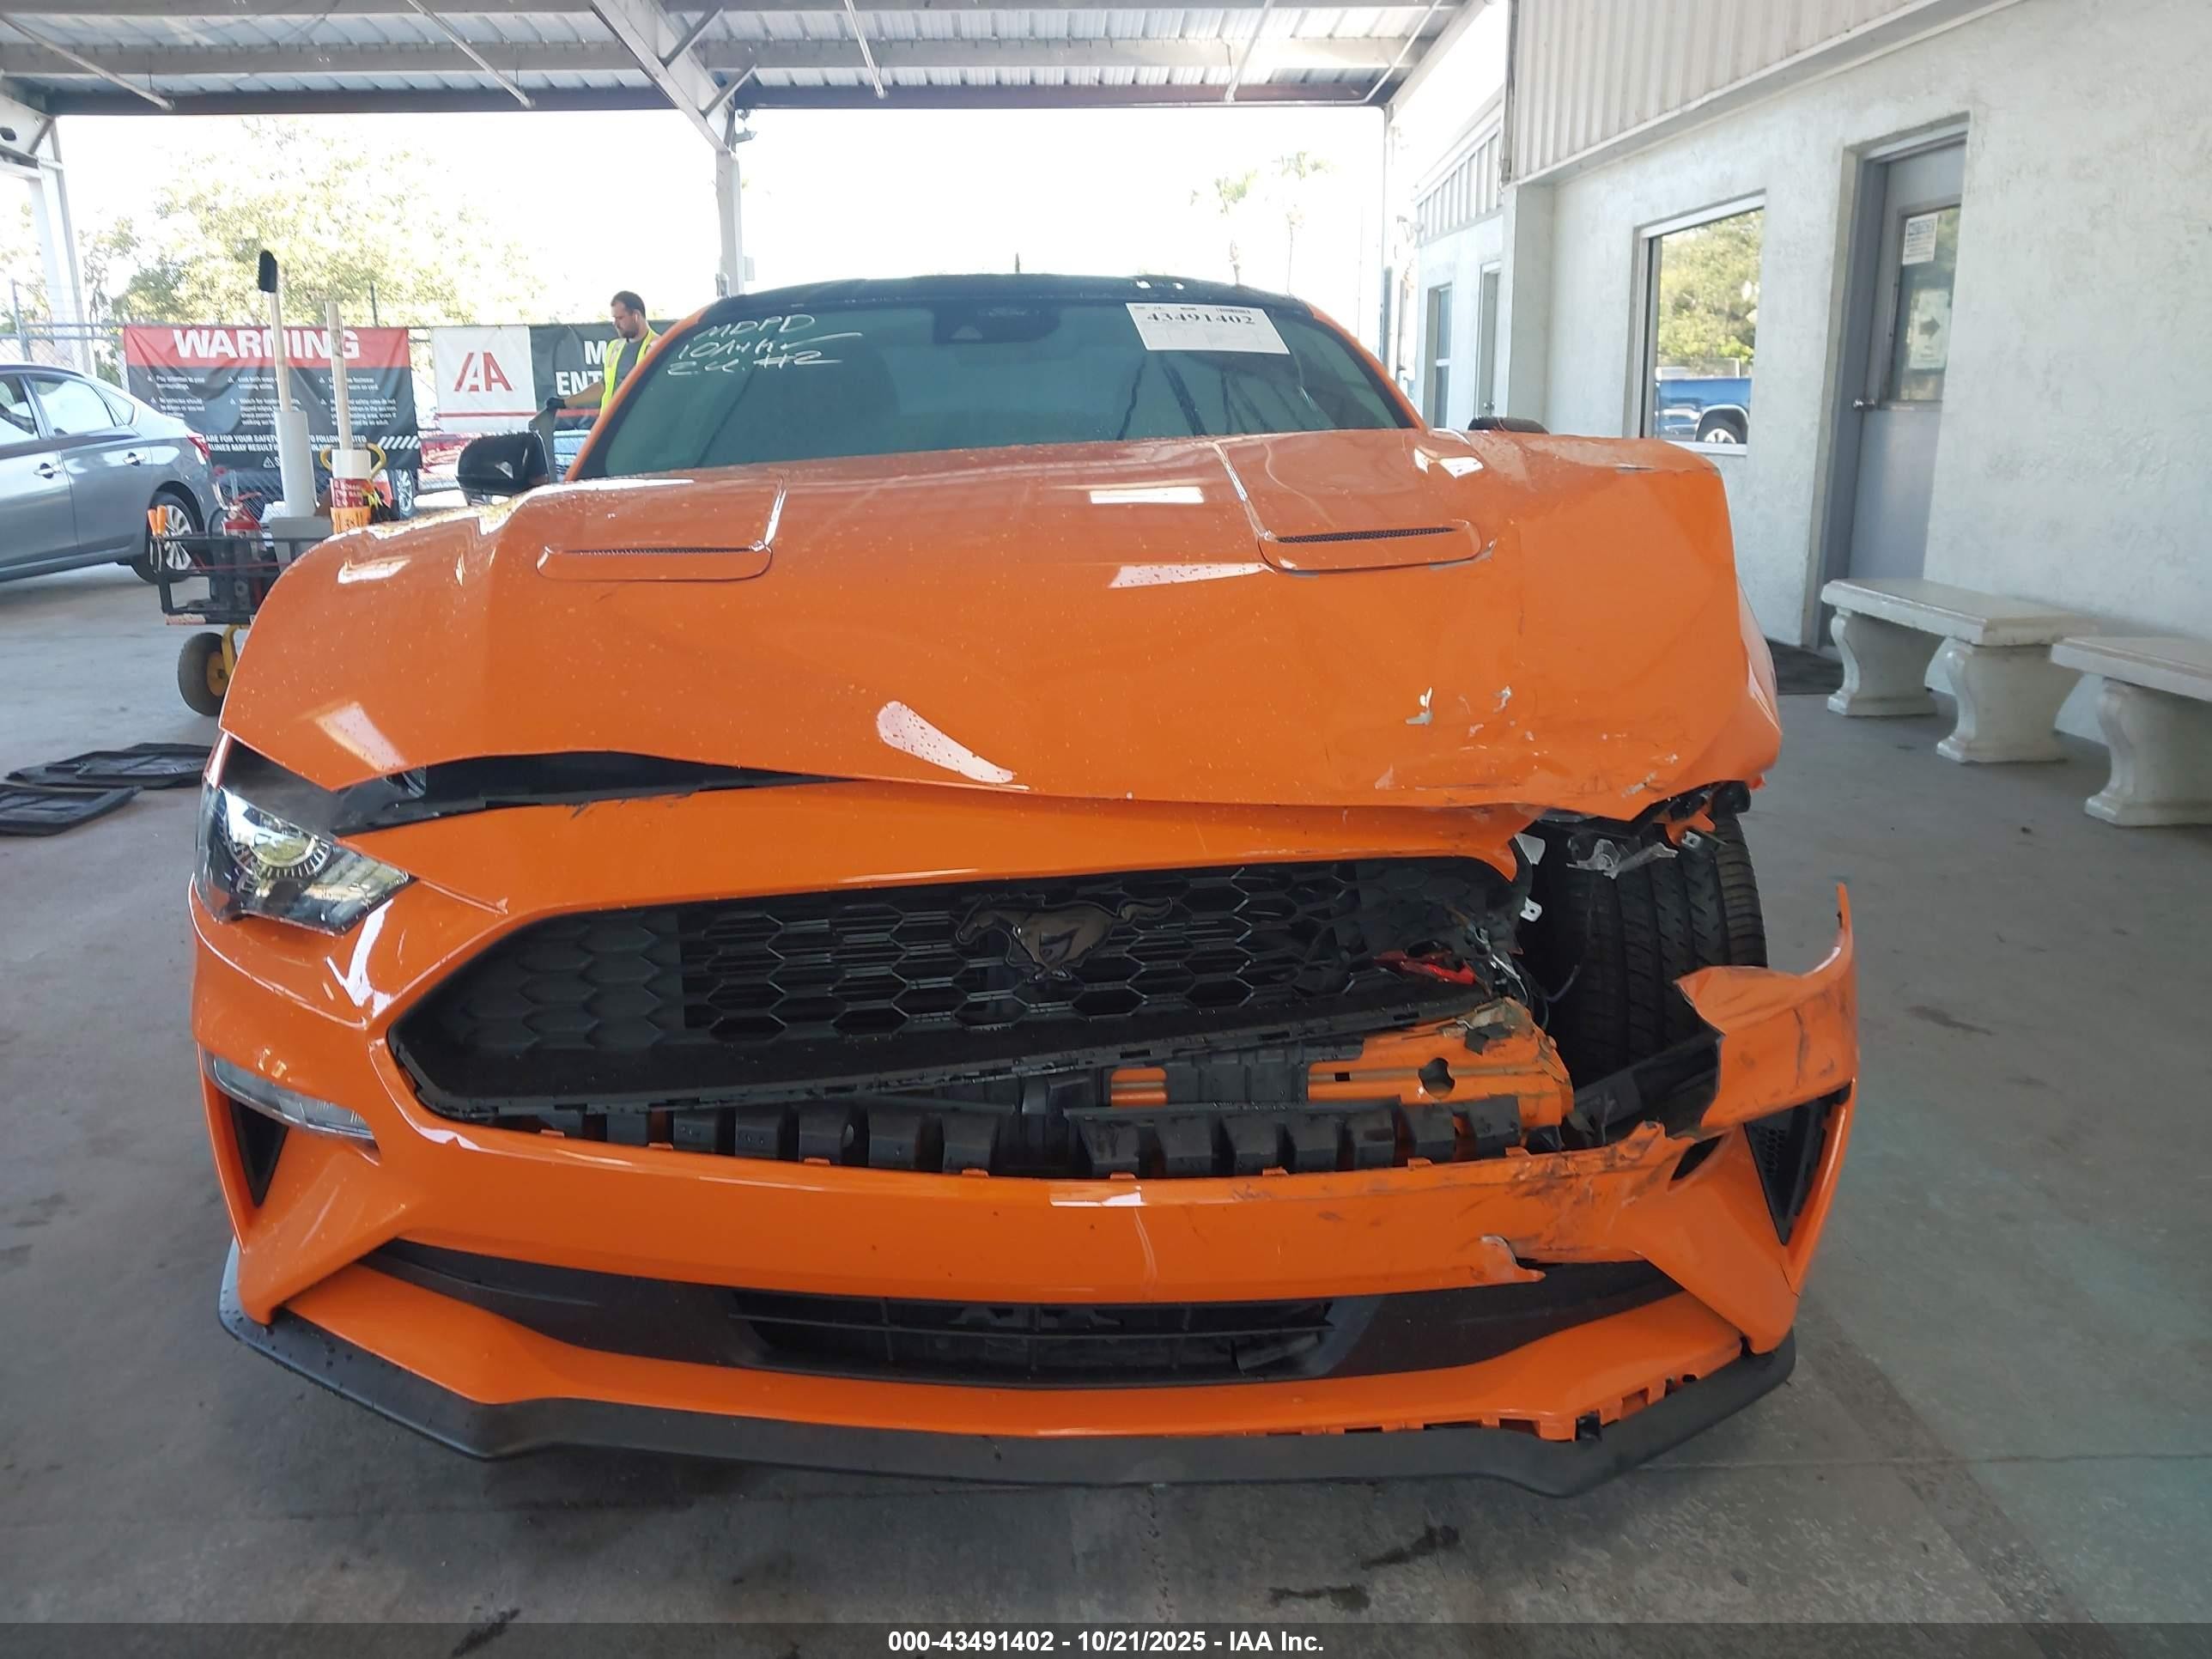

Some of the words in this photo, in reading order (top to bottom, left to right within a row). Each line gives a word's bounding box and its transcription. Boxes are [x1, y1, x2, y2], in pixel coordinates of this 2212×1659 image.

[1147, 312, 1255, 325] 43491402
[173, 329, 360, 359] WARNING
[219, 434, 234, 443] FOR
[234, 434, 253, 443] YOUR
[231, 443, 246, 452] MAY
[247, 443, 273, 452] RESULT
